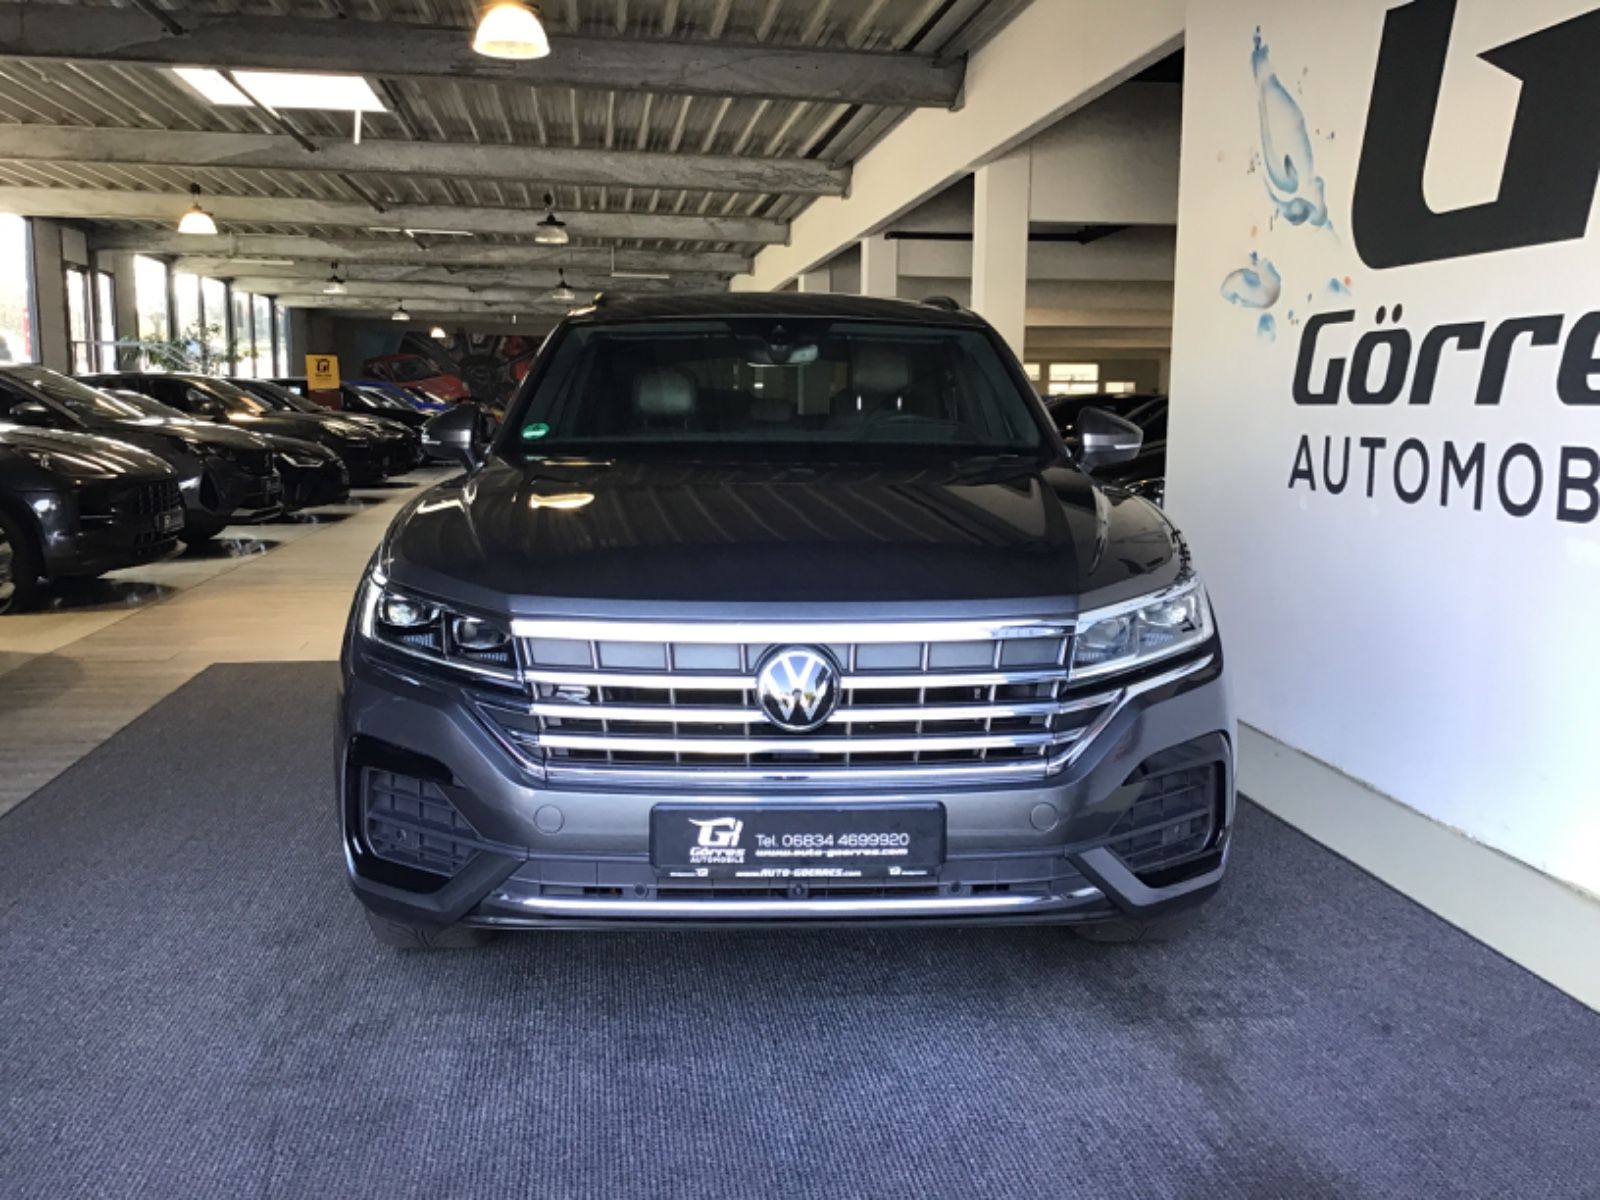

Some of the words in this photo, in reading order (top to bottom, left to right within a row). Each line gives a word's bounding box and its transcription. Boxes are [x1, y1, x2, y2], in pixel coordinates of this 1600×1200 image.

[1288, 434, 1600, 523] AUTOMOB
[755, 834, 779, 847] Tel.
[782, 833, 834, 848] 06834
[837, 832, 910, 846] 4699920
